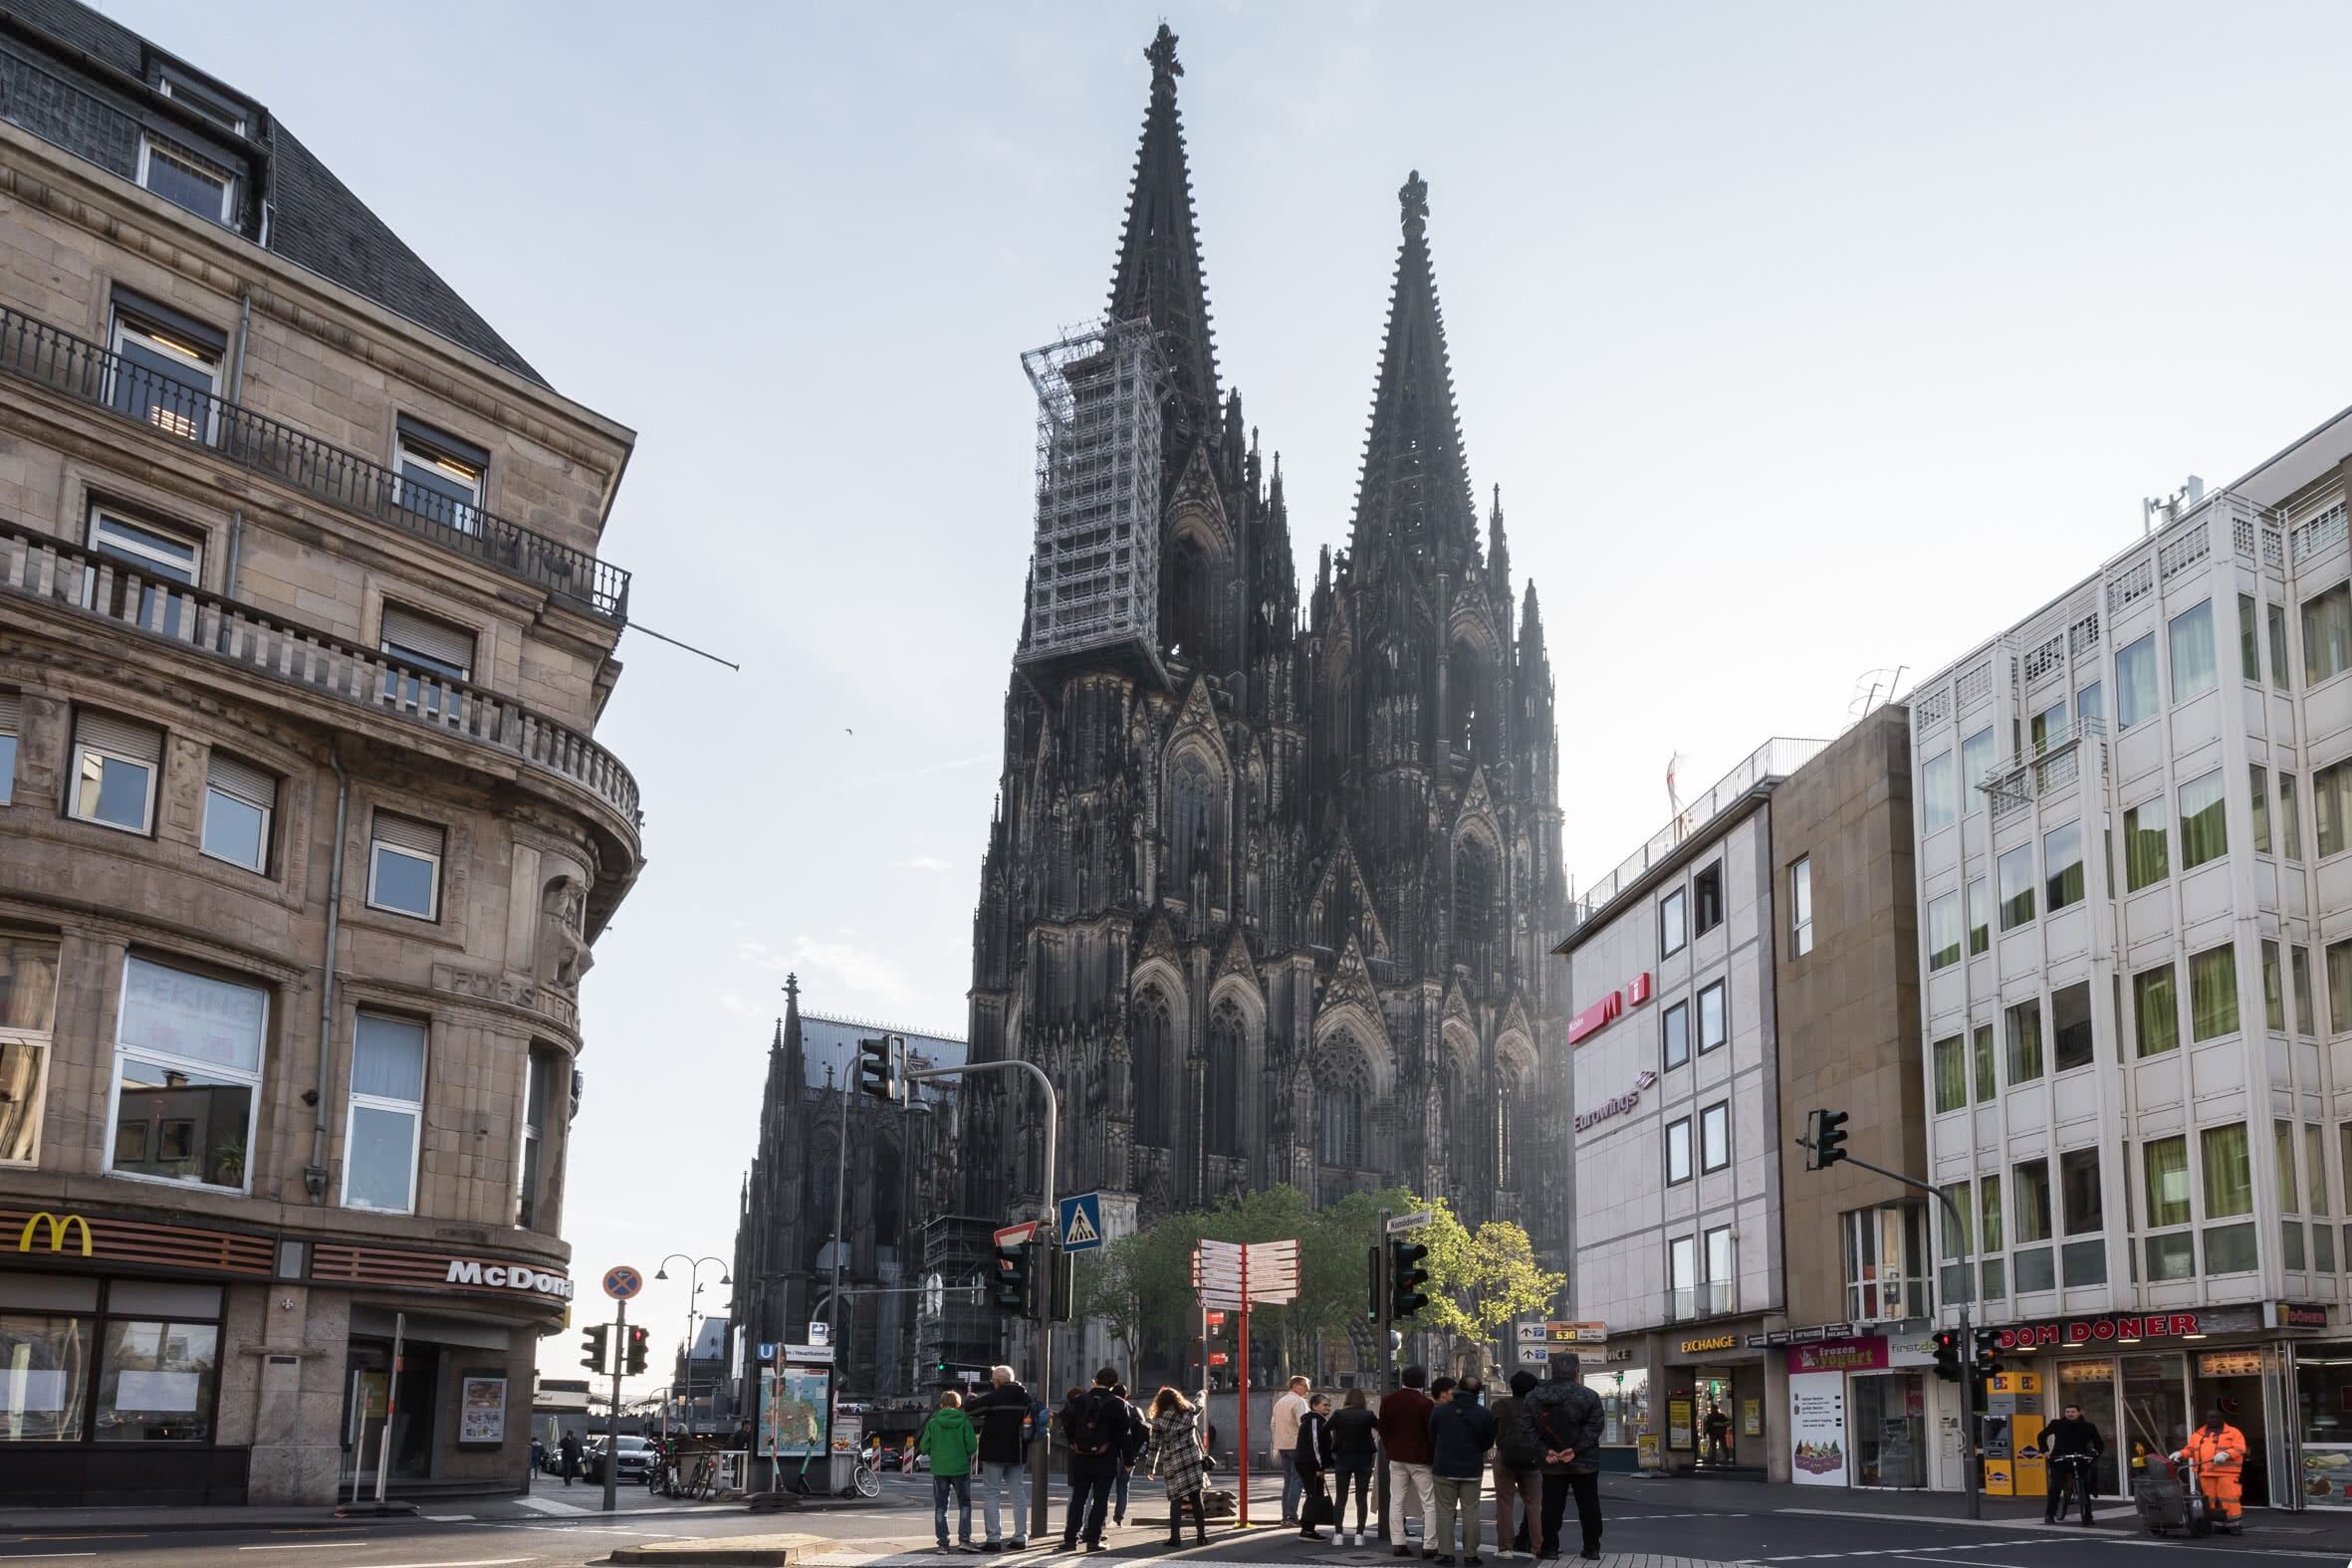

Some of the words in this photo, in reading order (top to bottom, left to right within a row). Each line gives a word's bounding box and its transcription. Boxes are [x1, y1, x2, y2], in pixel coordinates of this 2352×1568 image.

[1573, 1090, 1639, 1132] Eurowings
[1555, 1330, 1576, 1340] 630
[1681, 1335, 1736, 1353] EXCHANGE
[1999, 1324, 2060, 1348] DOM
[760, 1345, 774, 1359] U
[1818, 1347, 1873, 1369] yogurt
[1819, 1346, 1856, 1356] frozen
